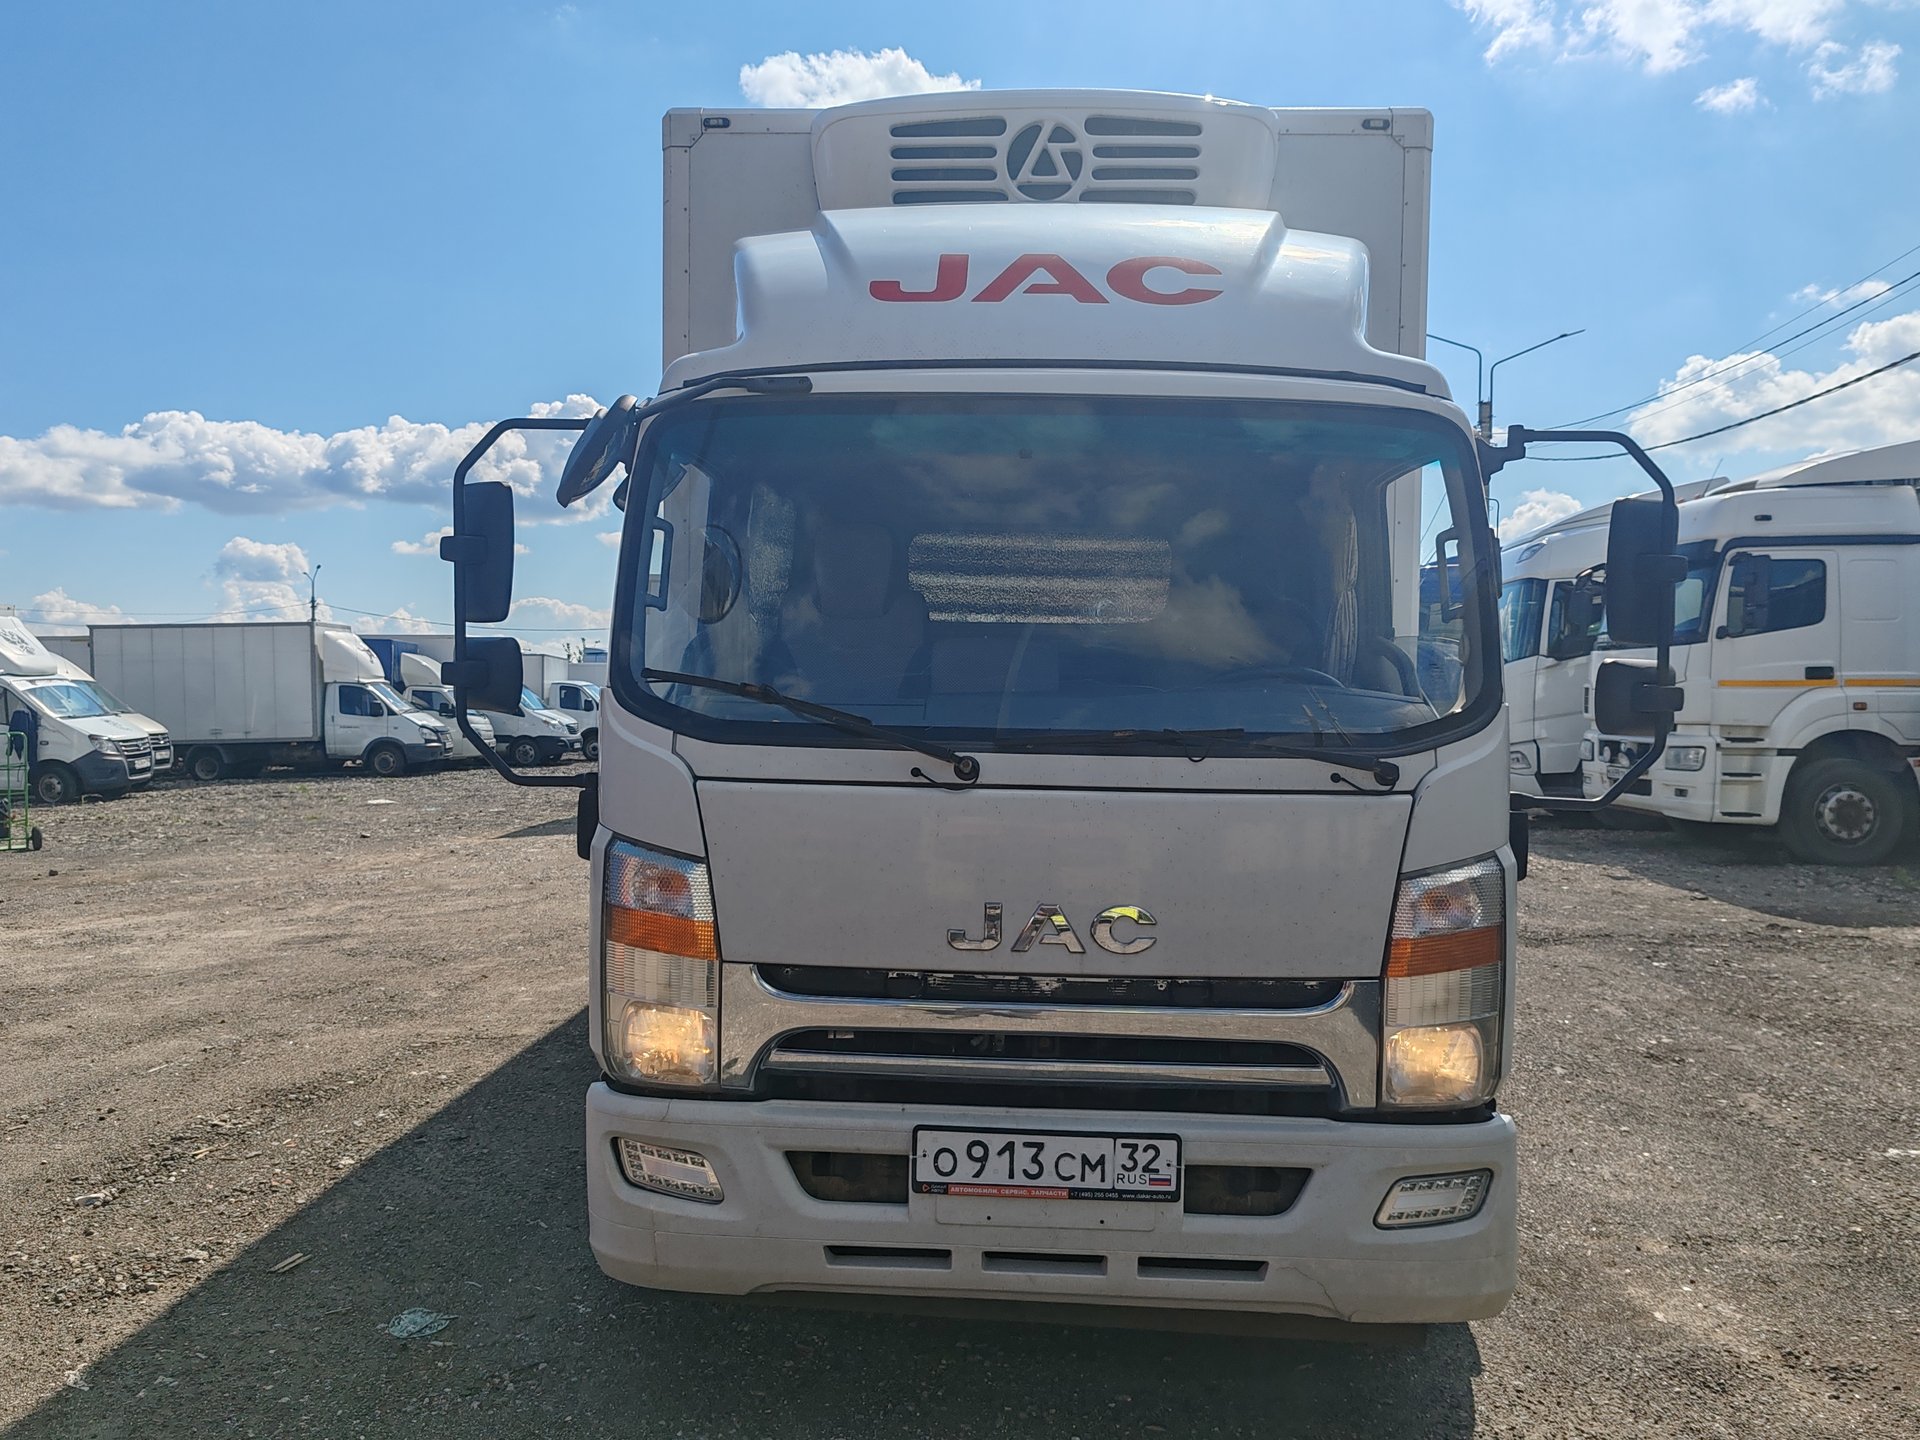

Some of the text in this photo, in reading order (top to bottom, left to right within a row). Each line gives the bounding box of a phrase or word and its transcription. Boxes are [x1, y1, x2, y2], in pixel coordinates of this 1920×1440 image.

[868, 252, 1225, 306] JAC
[947, 902, 1157, 954] JAC
[1120, 1143, 1161, 1173] 32
[1030, 1189, 1068, 1198] ЗАПЧАСТИ
[1116, 1173, 1147, 1185] RUS
